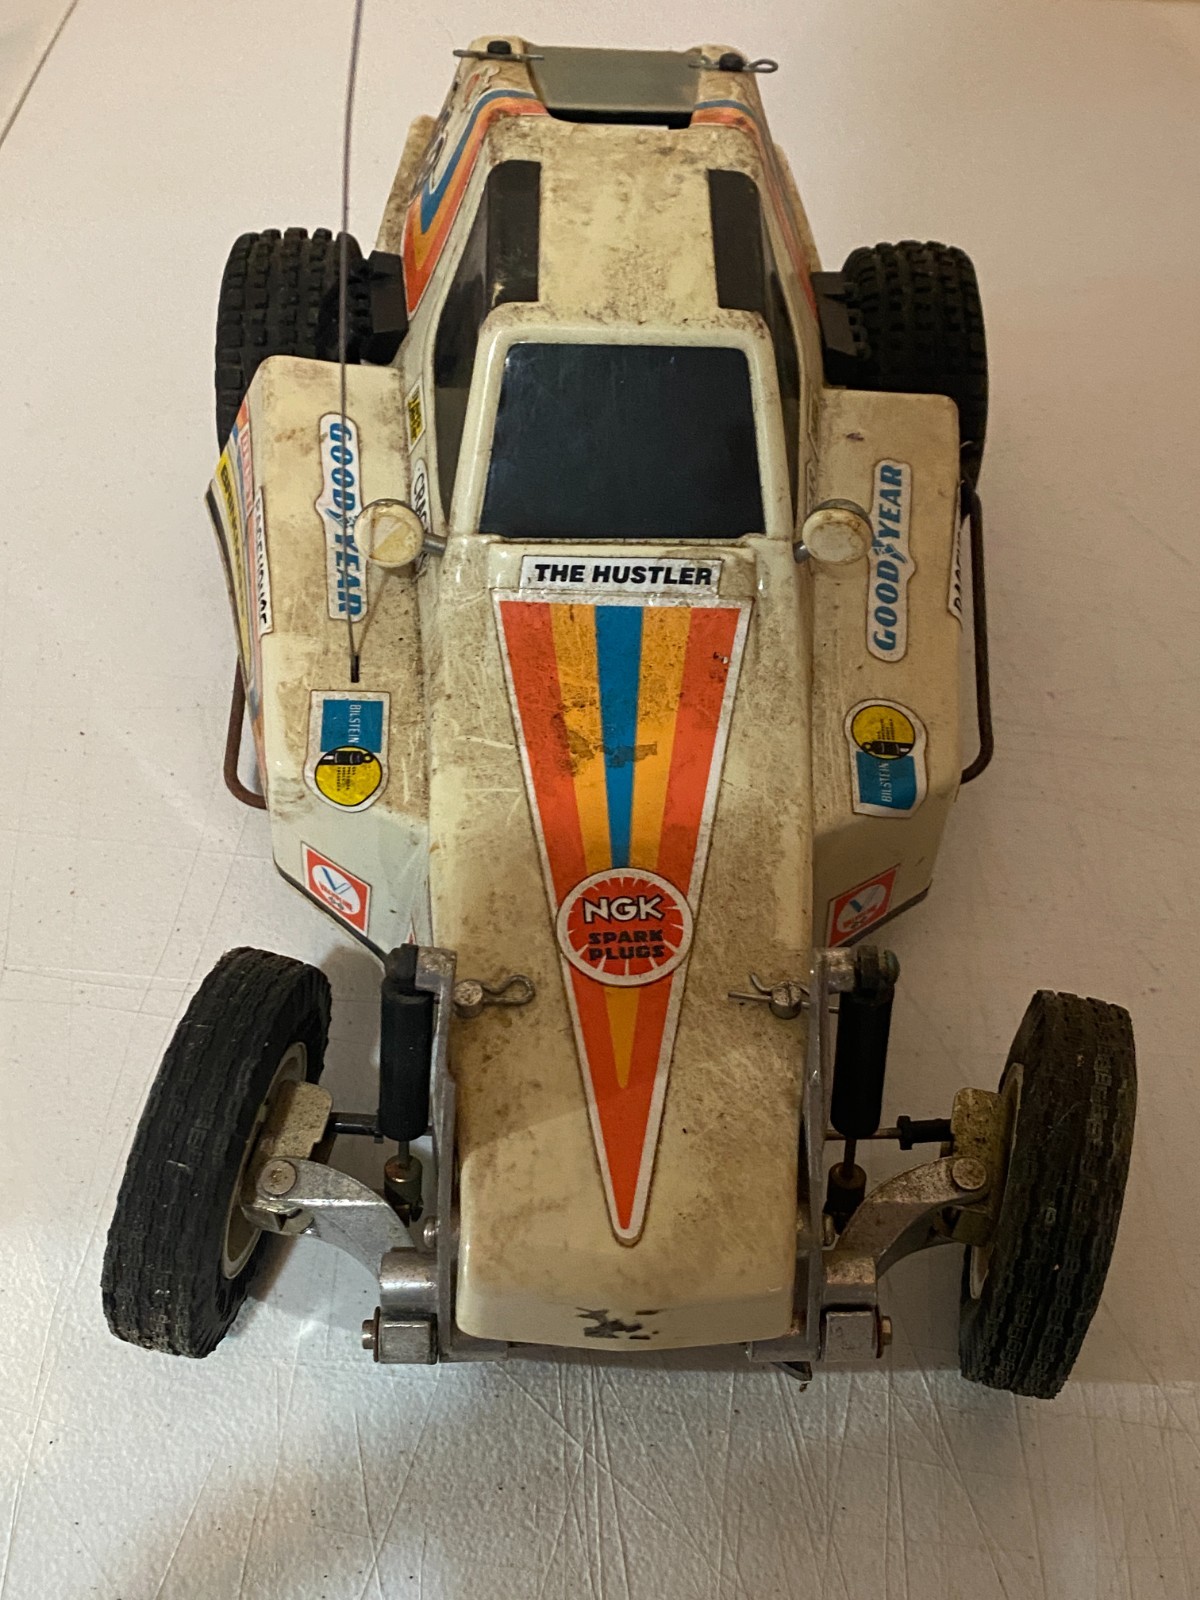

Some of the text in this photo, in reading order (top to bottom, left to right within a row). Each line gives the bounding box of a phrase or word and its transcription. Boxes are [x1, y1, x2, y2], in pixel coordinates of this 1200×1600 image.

[534, 563, 713, 585] THE HUSTLER
[347, 703, 362, 744] BILSTEIN
[582, 893, 666, 924] NGK
[587, 929, 664, 945] SPARK
[588, 944, 666, 962] PLUGS
